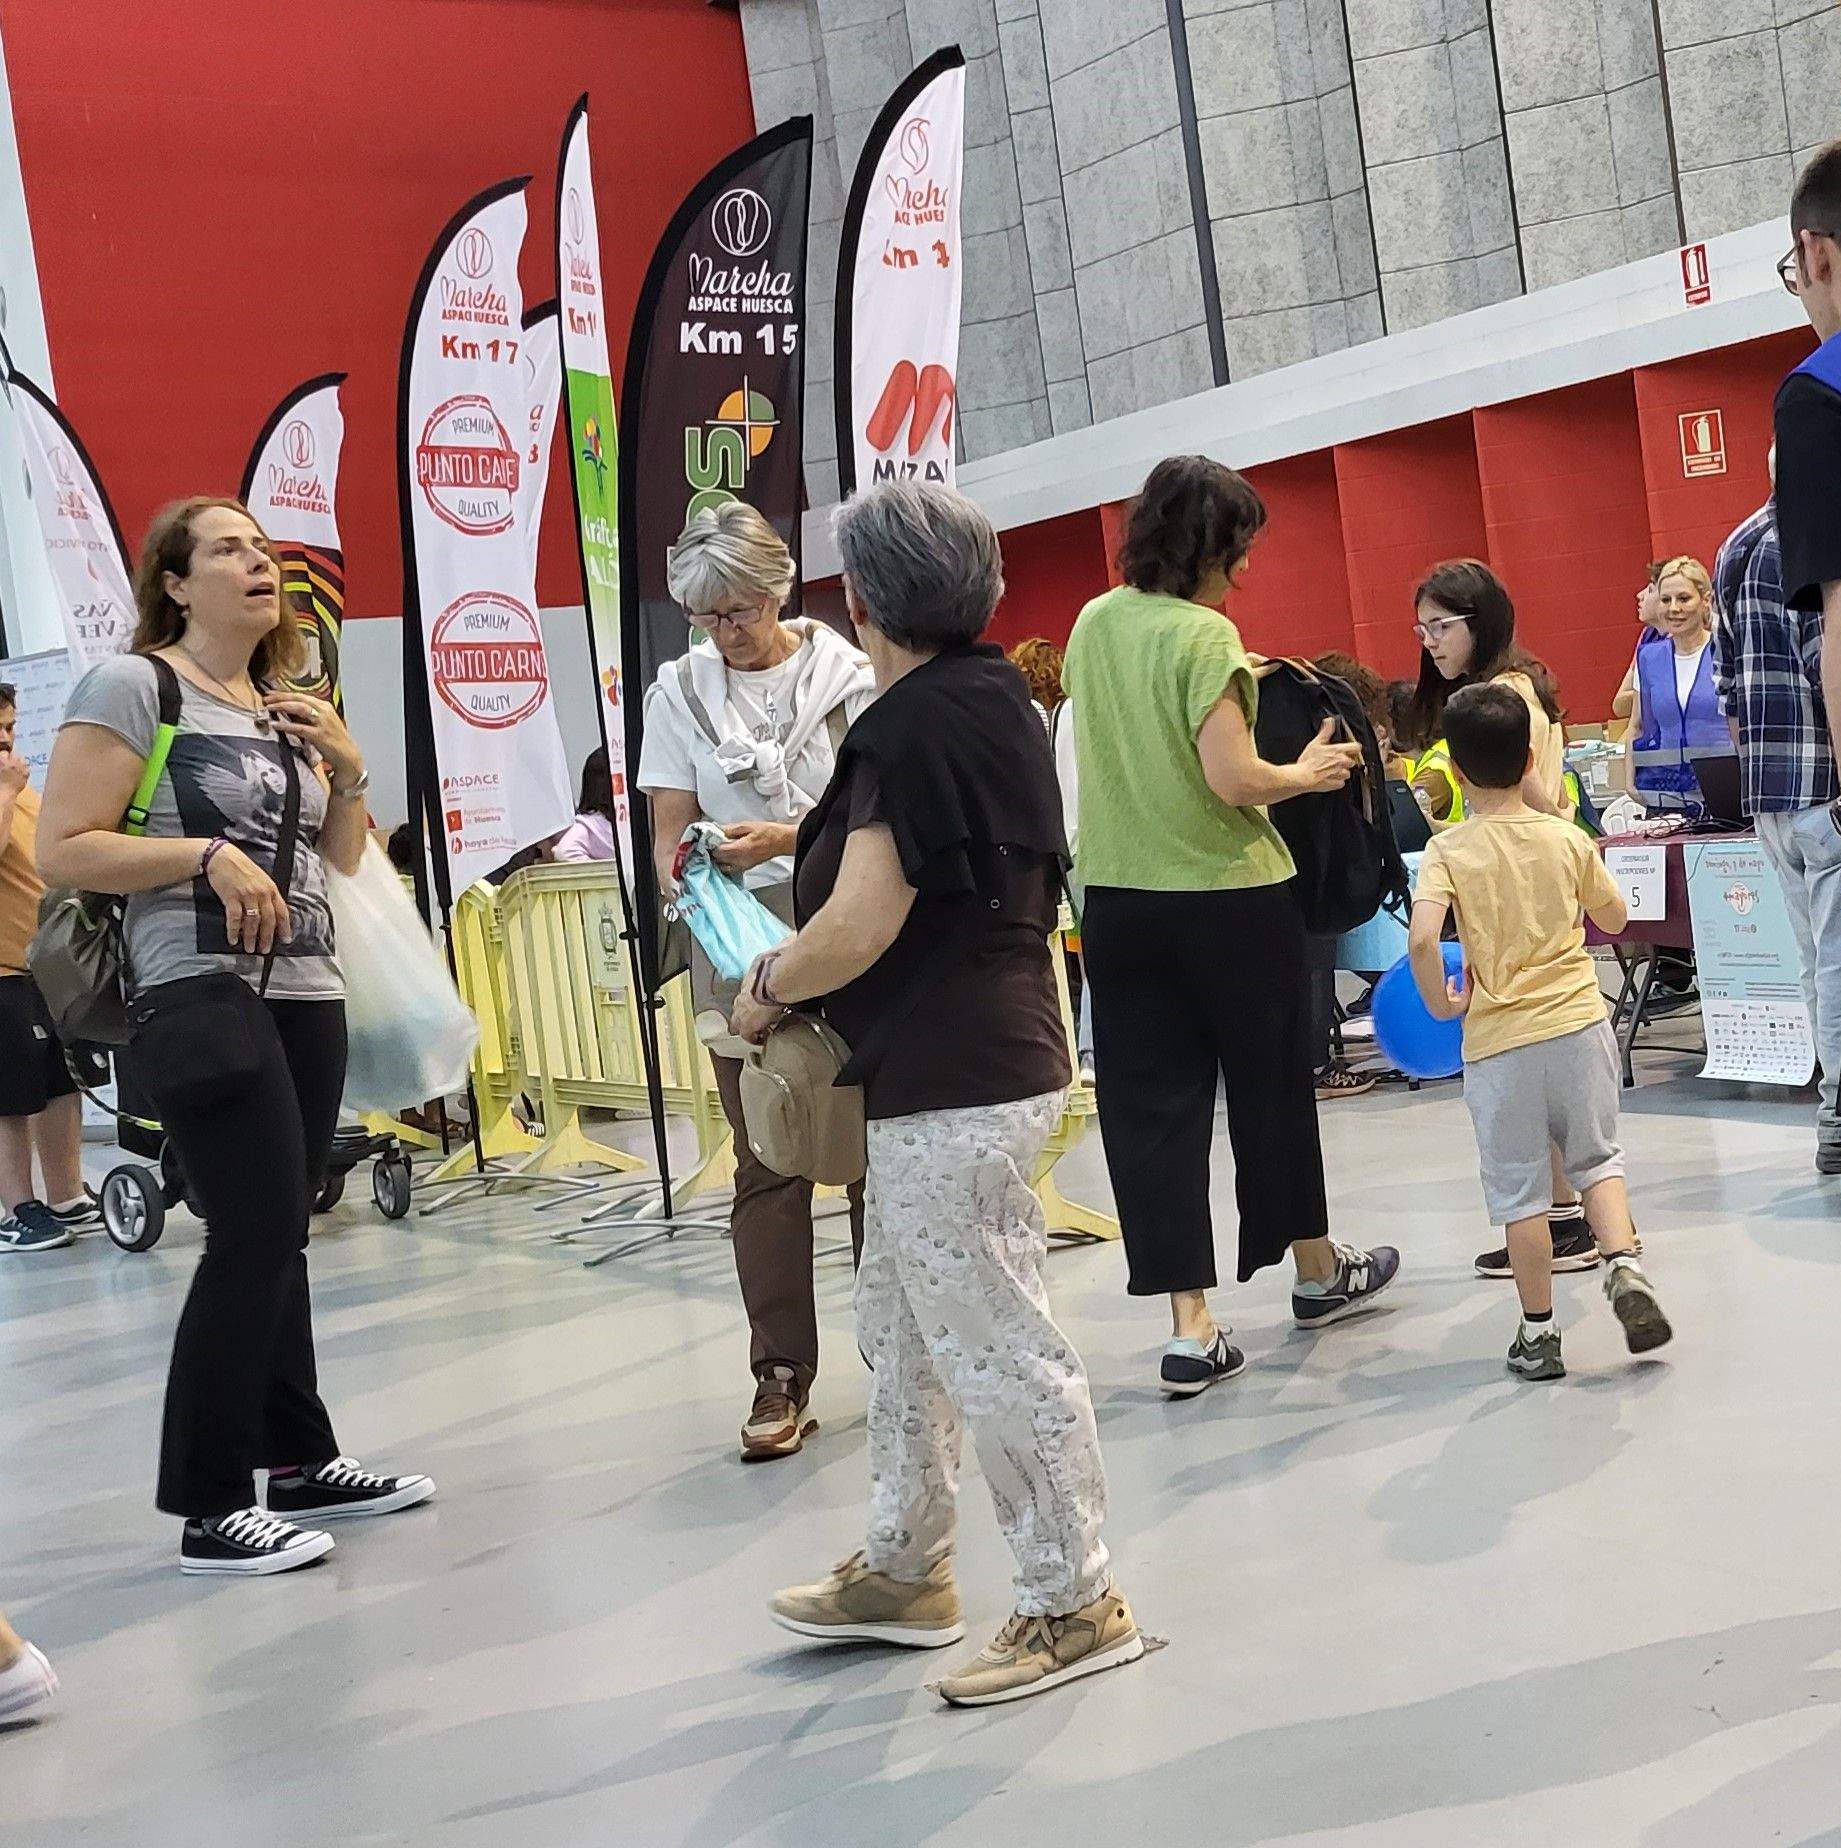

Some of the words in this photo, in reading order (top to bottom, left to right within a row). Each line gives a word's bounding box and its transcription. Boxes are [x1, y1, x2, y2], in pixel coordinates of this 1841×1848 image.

[689, 252, 795, 297] Marcha
[687, 296, 738, 313] ASPACE
[741, 298, 794, 314] HUESCA
[441, 334, 482, 361] Km
[486, 338, 519, 365] 17
[680, 322, 743, 355] Km
[756, 324, 799, 356] 15
[419, 452, 472, 485] PUNTO
[458, 498, 500, 519] QUALITY
[464, 613, 511, 632] PREMIUM
[431, 650, 487, 680] PUNTO
[1631, 886, 1641, 908] 5
